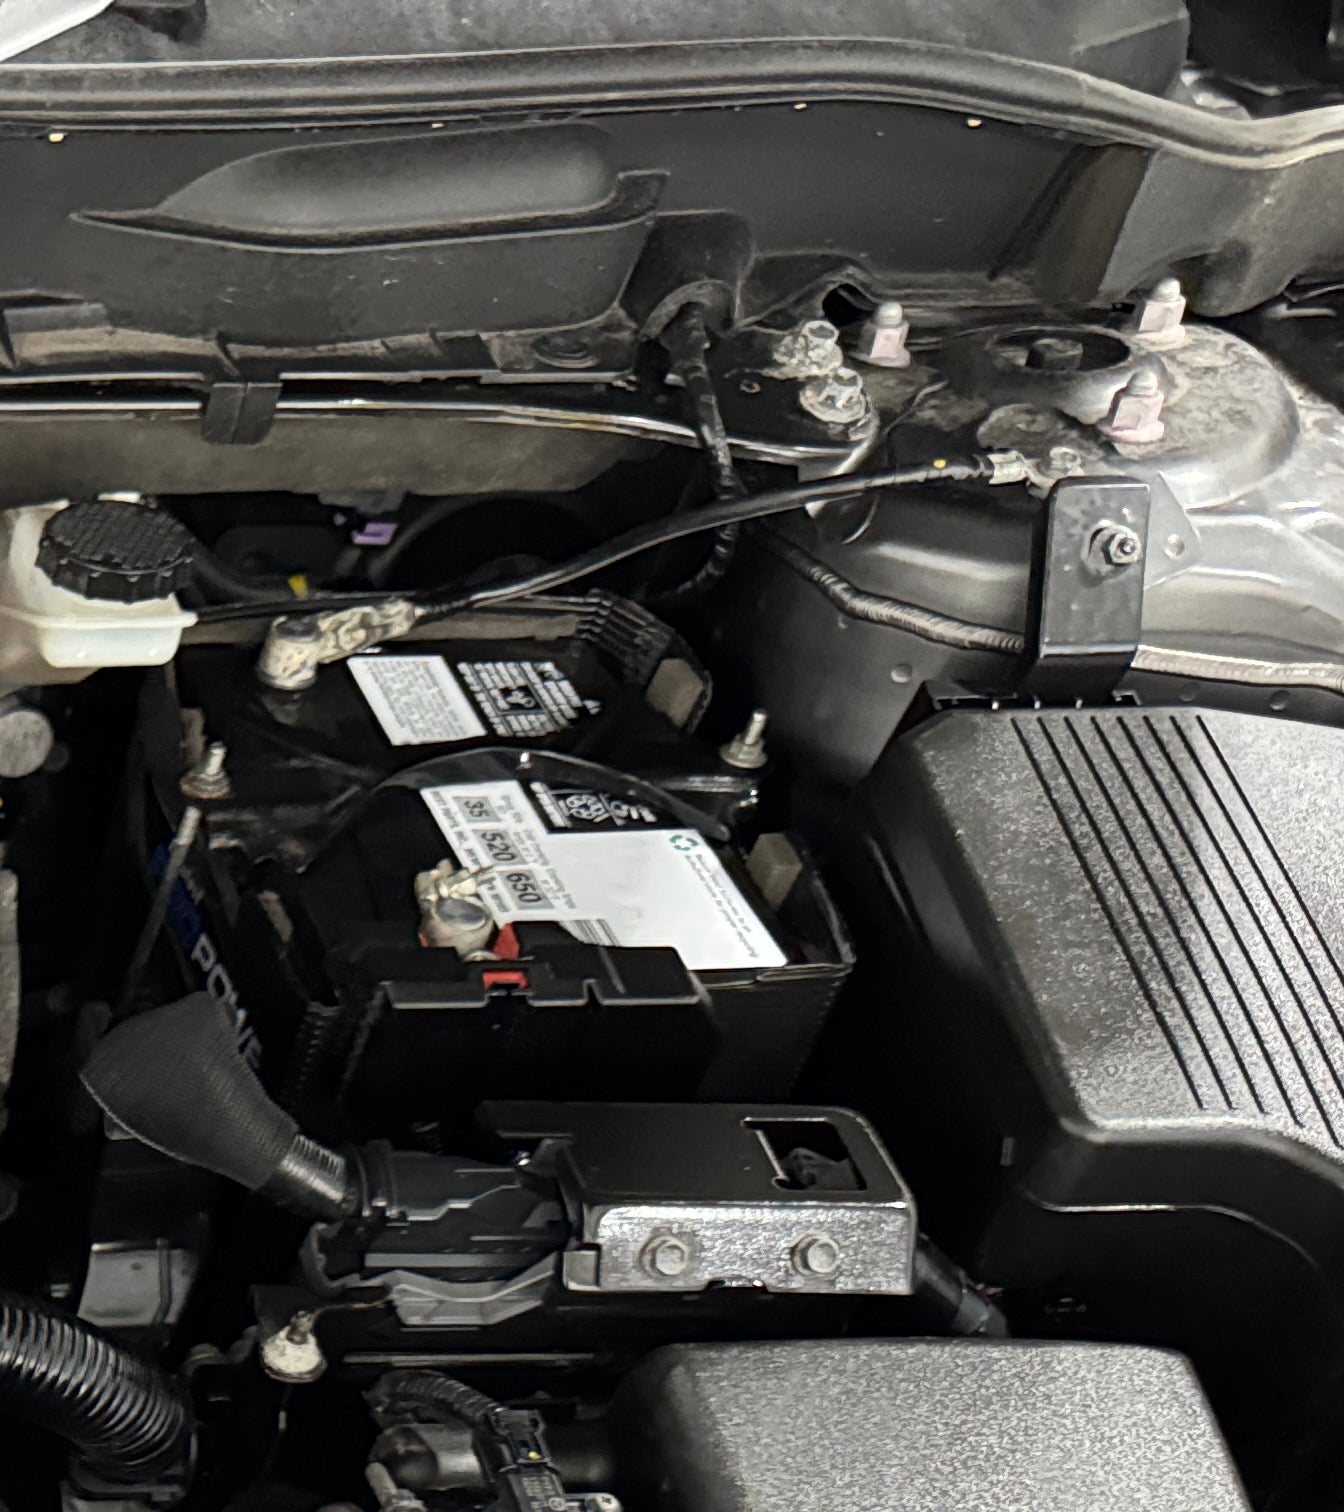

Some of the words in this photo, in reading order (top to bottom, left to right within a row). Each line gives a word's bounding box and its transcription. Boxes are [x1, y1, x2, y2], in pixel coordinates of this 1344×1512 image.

[465, 801, 489, 818] 35
[481, 833, 515, 861] 520
[507, 873, 541, 902] 650
